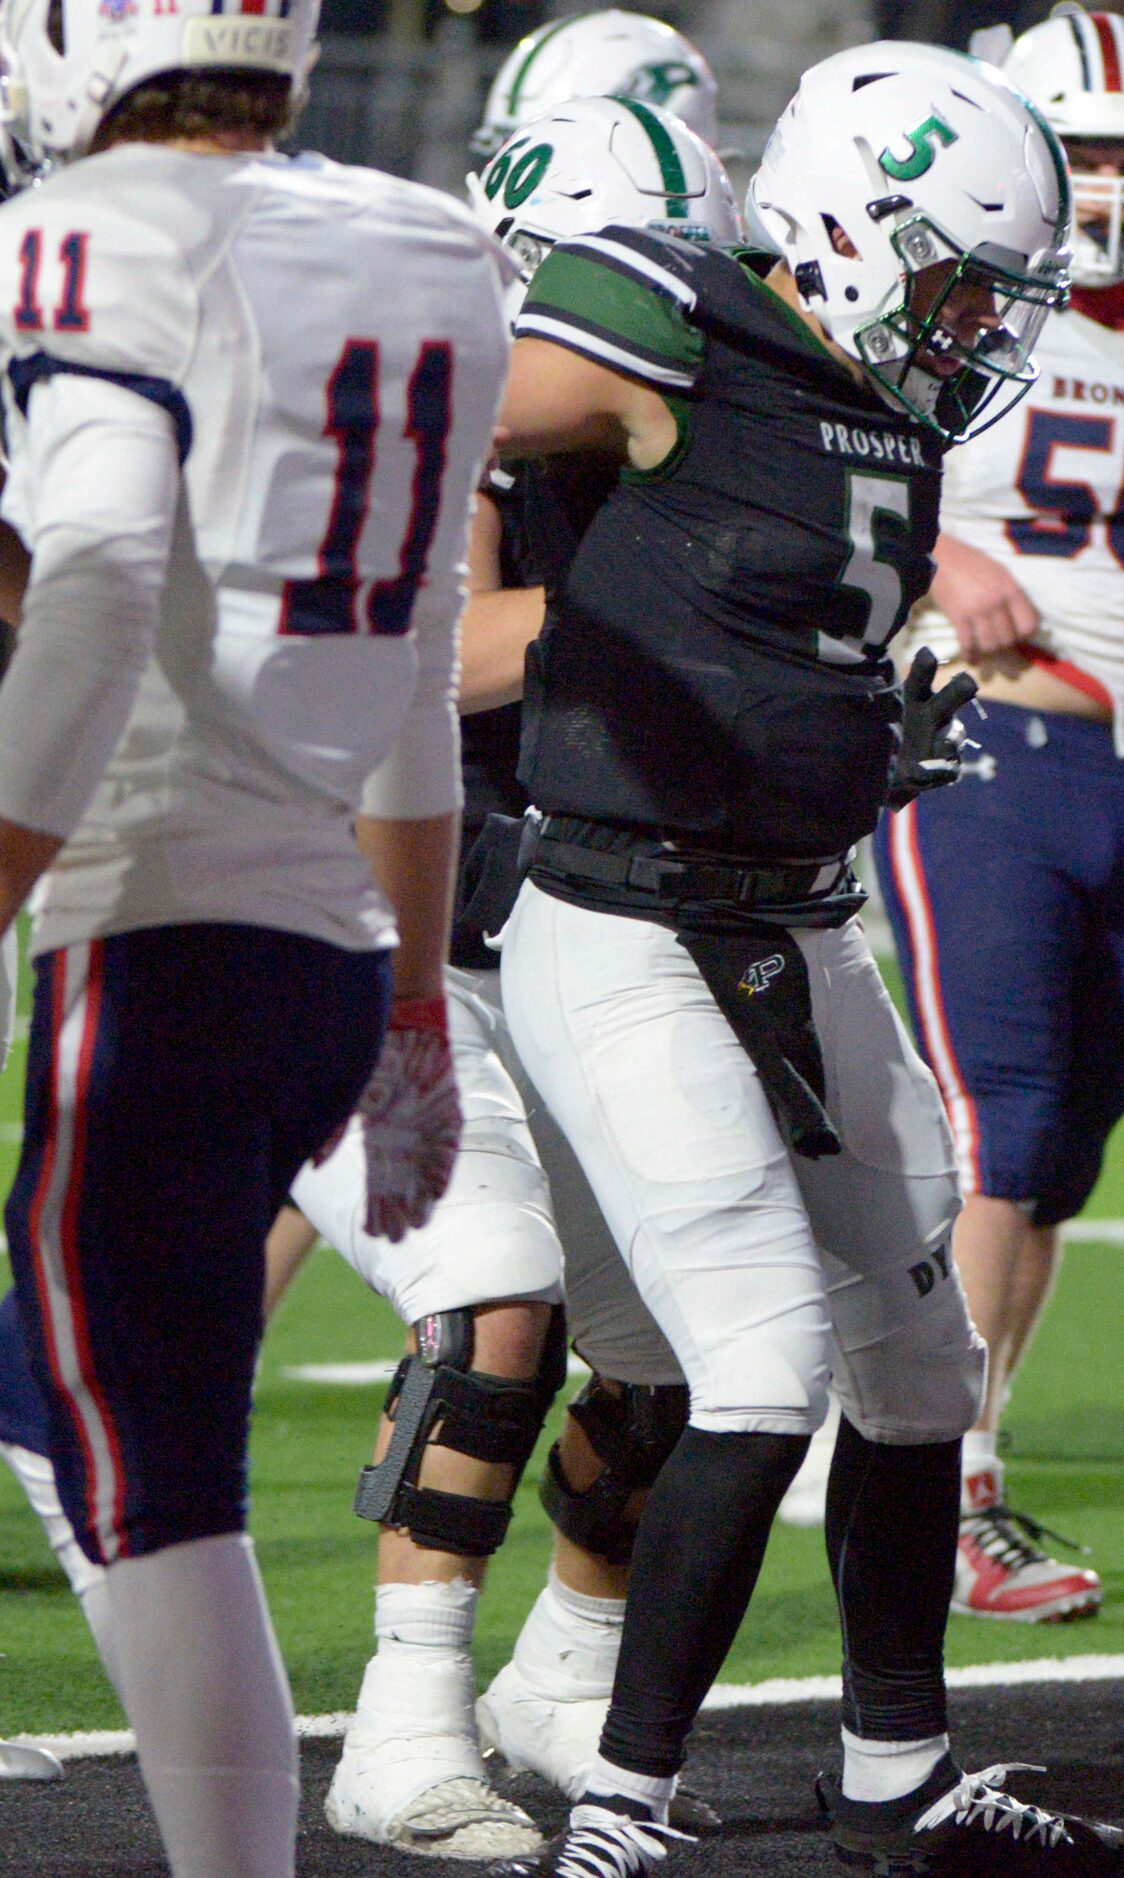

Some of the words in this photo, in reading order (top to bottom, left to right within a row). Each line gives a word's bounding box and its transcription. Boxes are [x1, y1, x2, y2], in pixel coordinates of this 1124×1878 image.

[203, 26, 288, 57] VICIS
[878, 114, 958, 182] 5
[13, 226, 92, 333] 11
[277, 338, 453, 636] 11
[819, 421, 926, 467] PROSPER
[816, 467, 911, 665] 5
